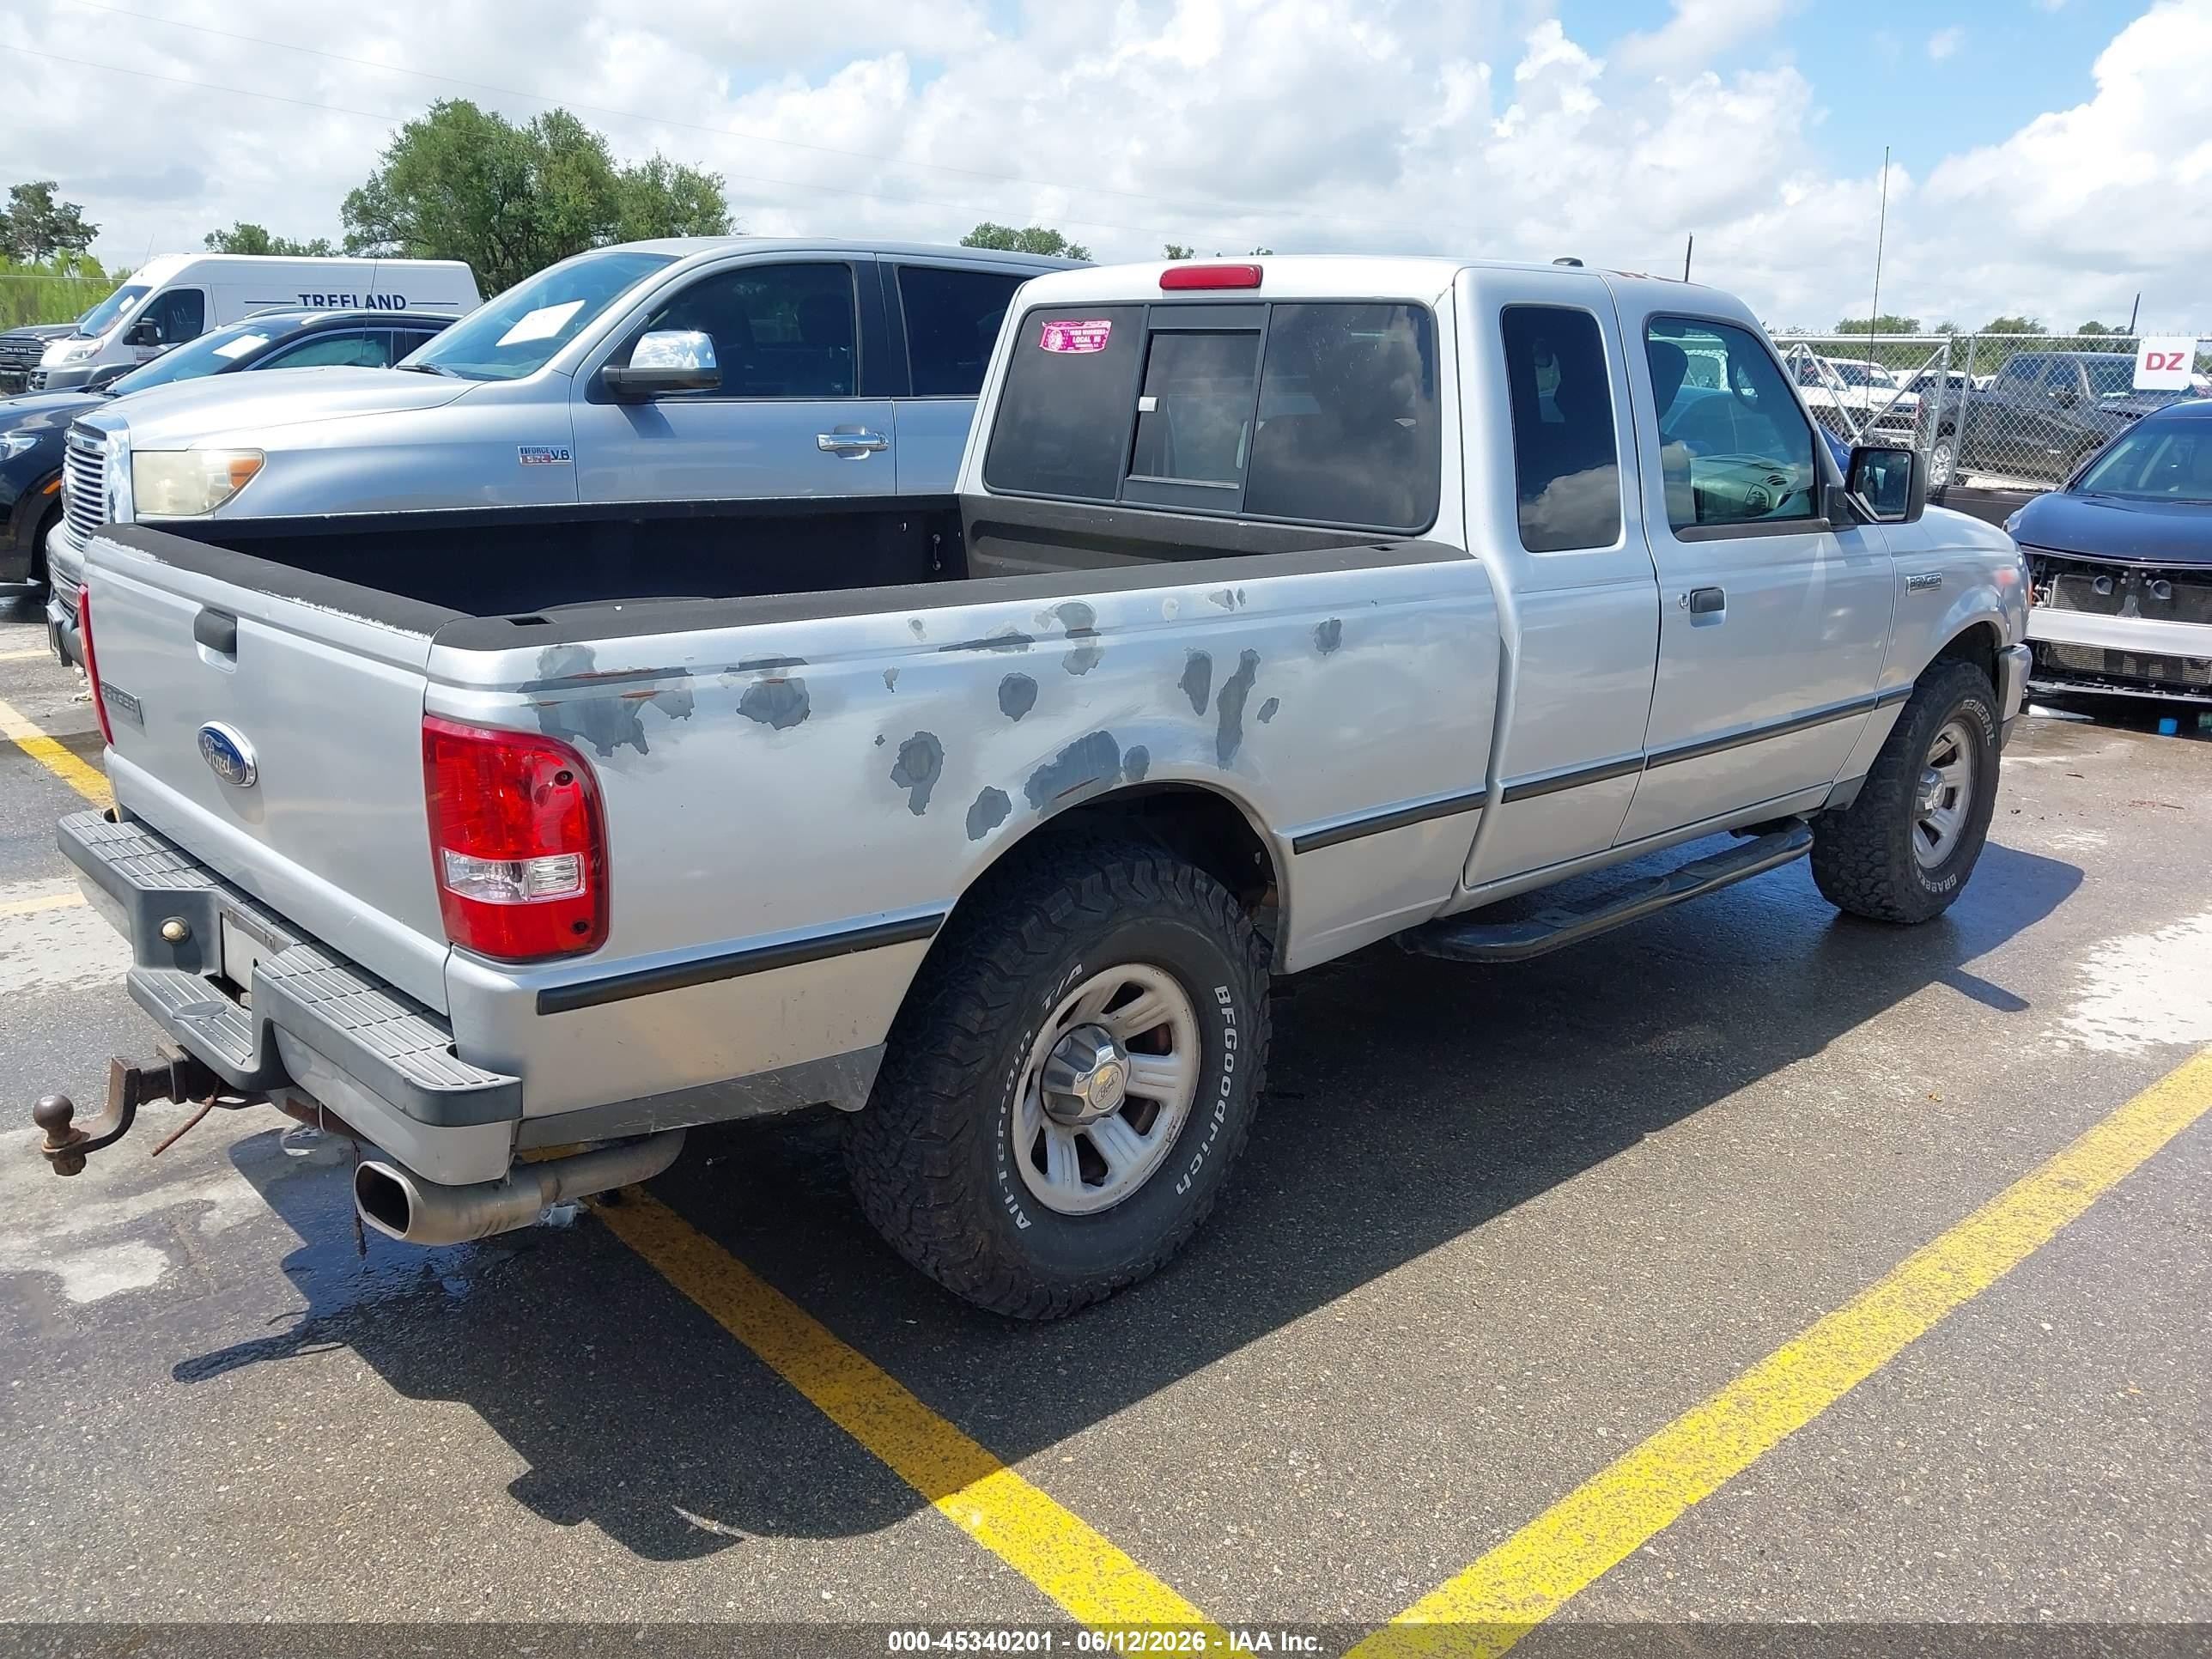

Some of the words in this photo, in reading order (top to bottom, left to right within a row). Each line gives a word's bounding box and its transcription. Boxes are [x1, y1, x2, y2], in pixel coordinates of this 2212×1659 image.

[297, 294, 406, 310] TREELAND
[2145, 352, 2185, 371] DZ
[1910, 574, 1942, 587] RANGER
[1960, 699, 1995, 746] GENERAL
[996, 1030, 1032, 1230] All-Terrain
[1041, 963, 1084, 1011] T/A
[1175, 985, 1238, 1195] BFGoodrich
